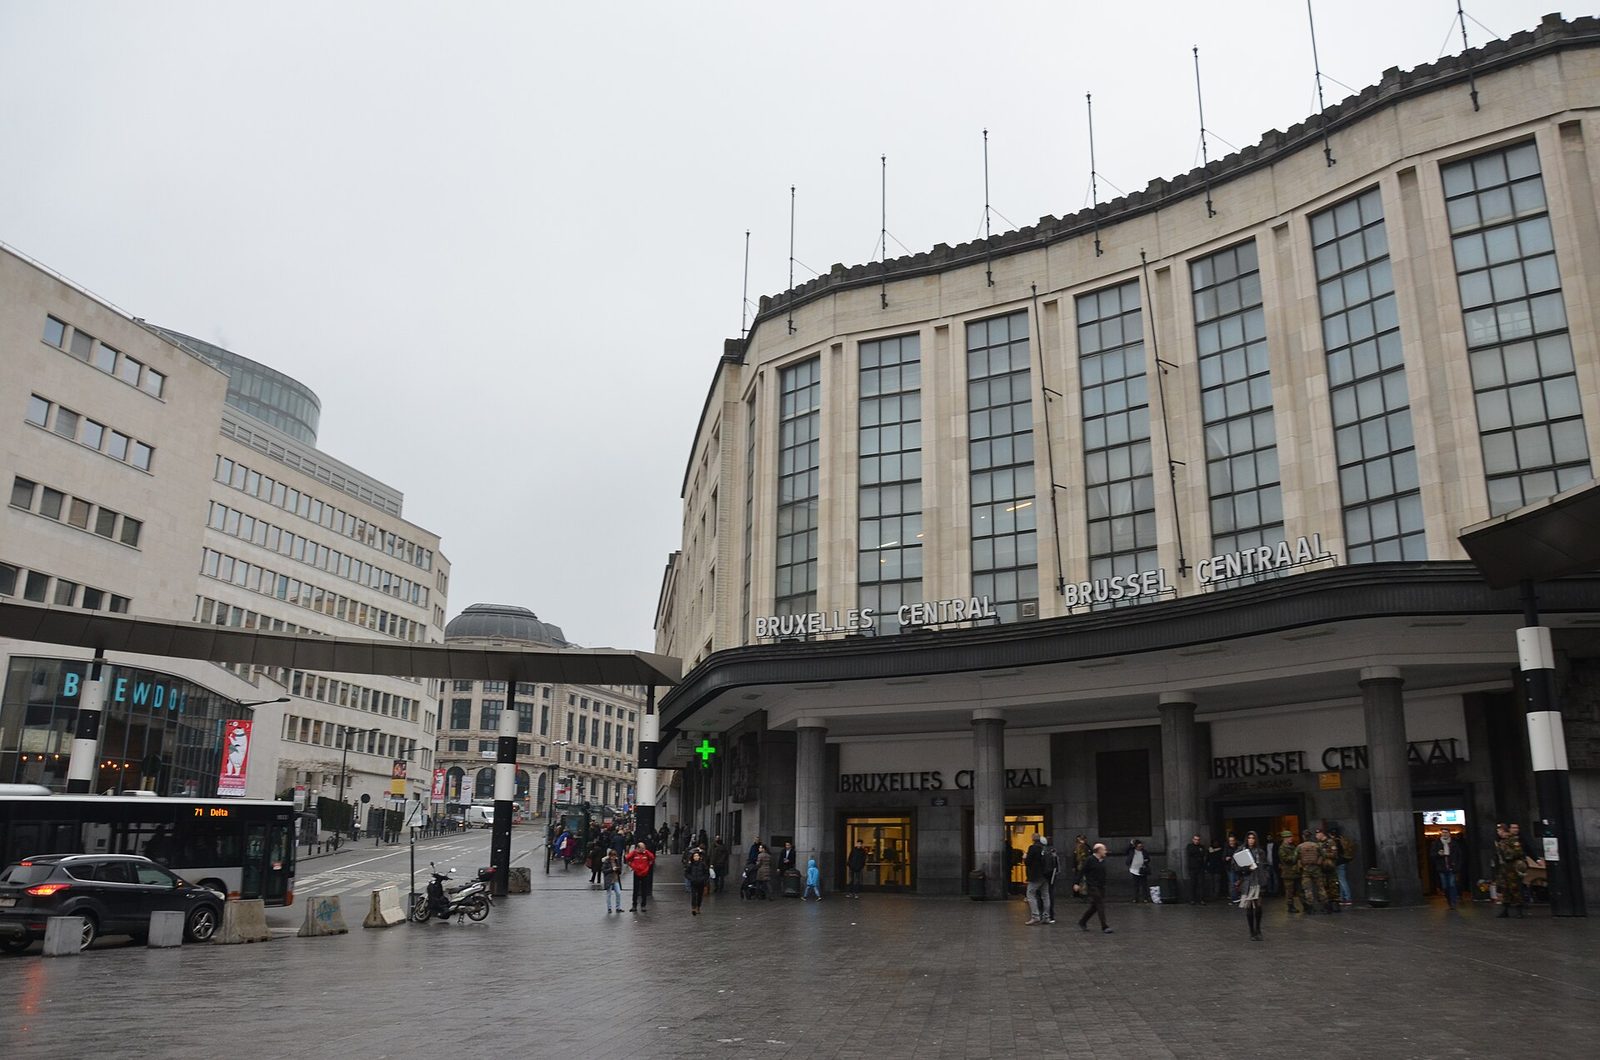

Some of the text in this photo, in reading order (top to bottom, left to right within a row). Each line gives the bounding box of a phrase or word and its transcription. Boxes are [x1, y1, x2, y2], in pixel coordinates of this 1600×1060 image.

[1064, 533, 1331, 607] BRUSSEL CENTRAAL
[755, 596, 998, 637] BRUXELLES CENTRAL
[63, 672, 187, 713] BEWDOG
[1213, 738, 1464, 778] BRUSSEL CENAAL
[841, 771, 943, 792] BRUXELLES
[194, 808, 229, 817] 71 Delta
